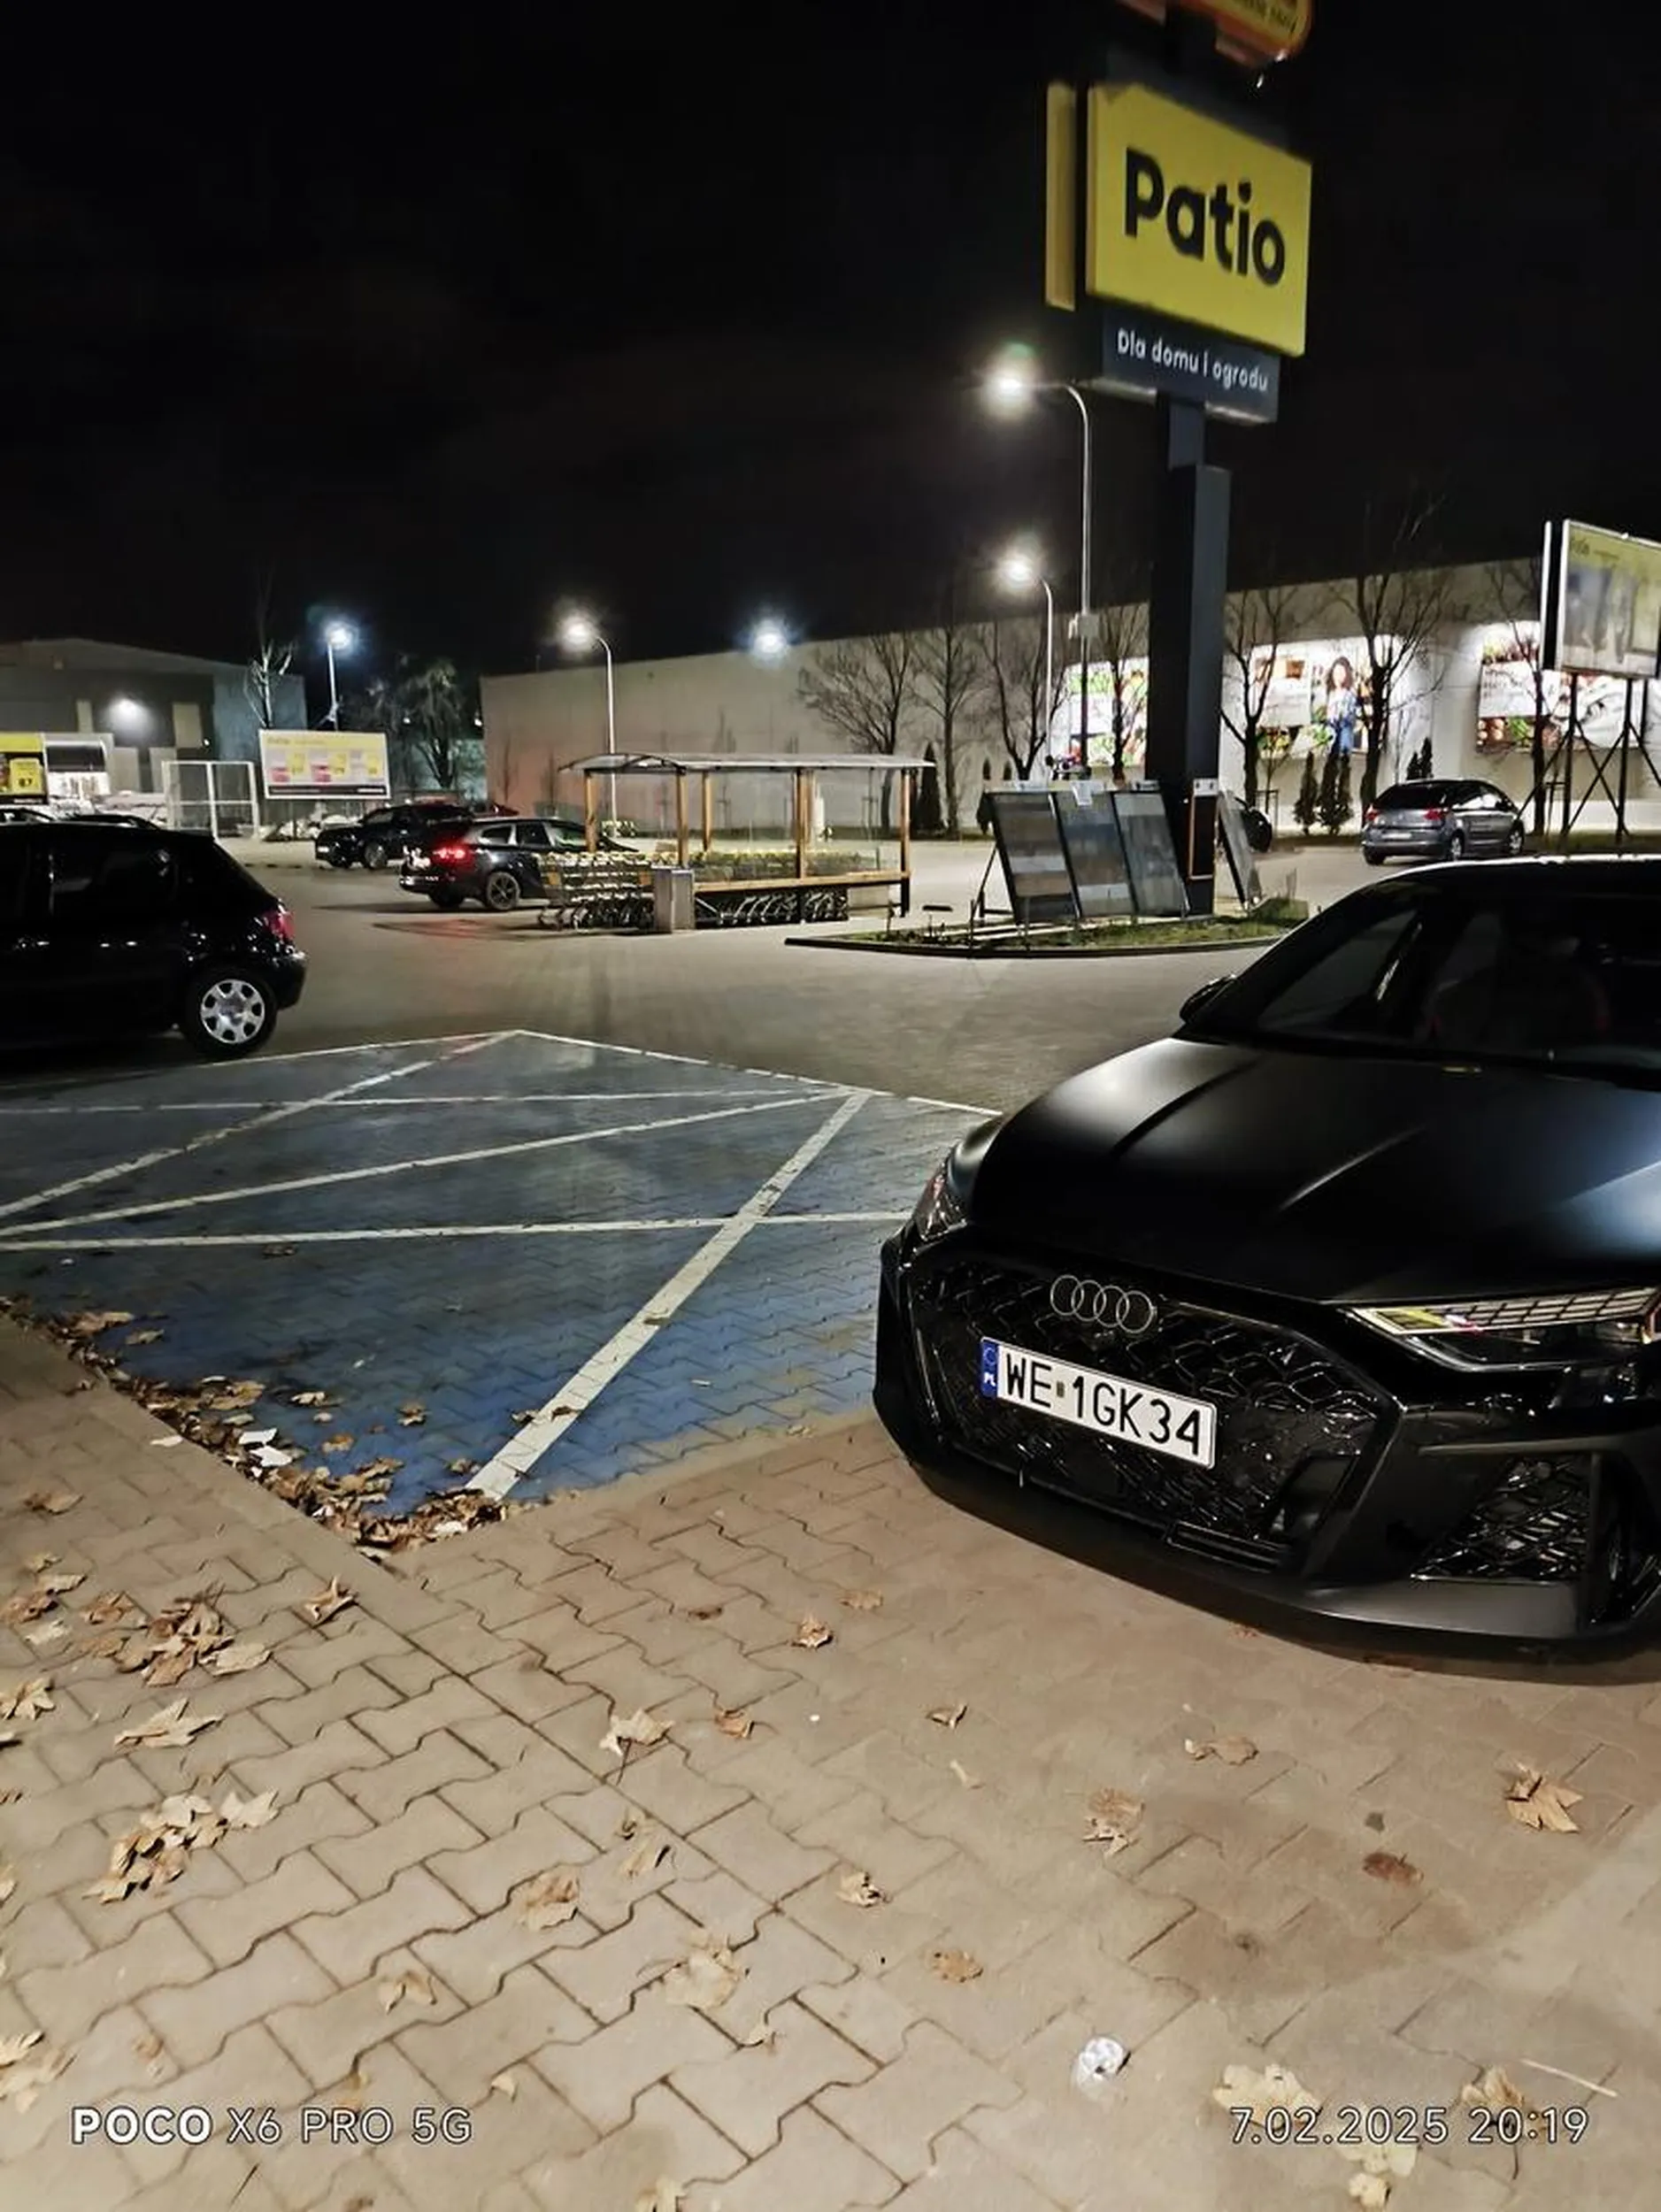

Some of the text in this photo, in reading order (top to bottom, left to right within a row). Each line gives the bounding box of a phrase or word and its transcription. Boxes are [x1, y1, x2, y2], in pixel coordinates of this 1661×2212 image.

[1125, 147, 1286, 288] Patio
[1118, 327, 1146, 359] Dla
[1152, 337, 1200, 373] domu
[1212, 361, 1268, 392] ogrodu
[1006, 1353, 1201, 1456] WE 1GK34
